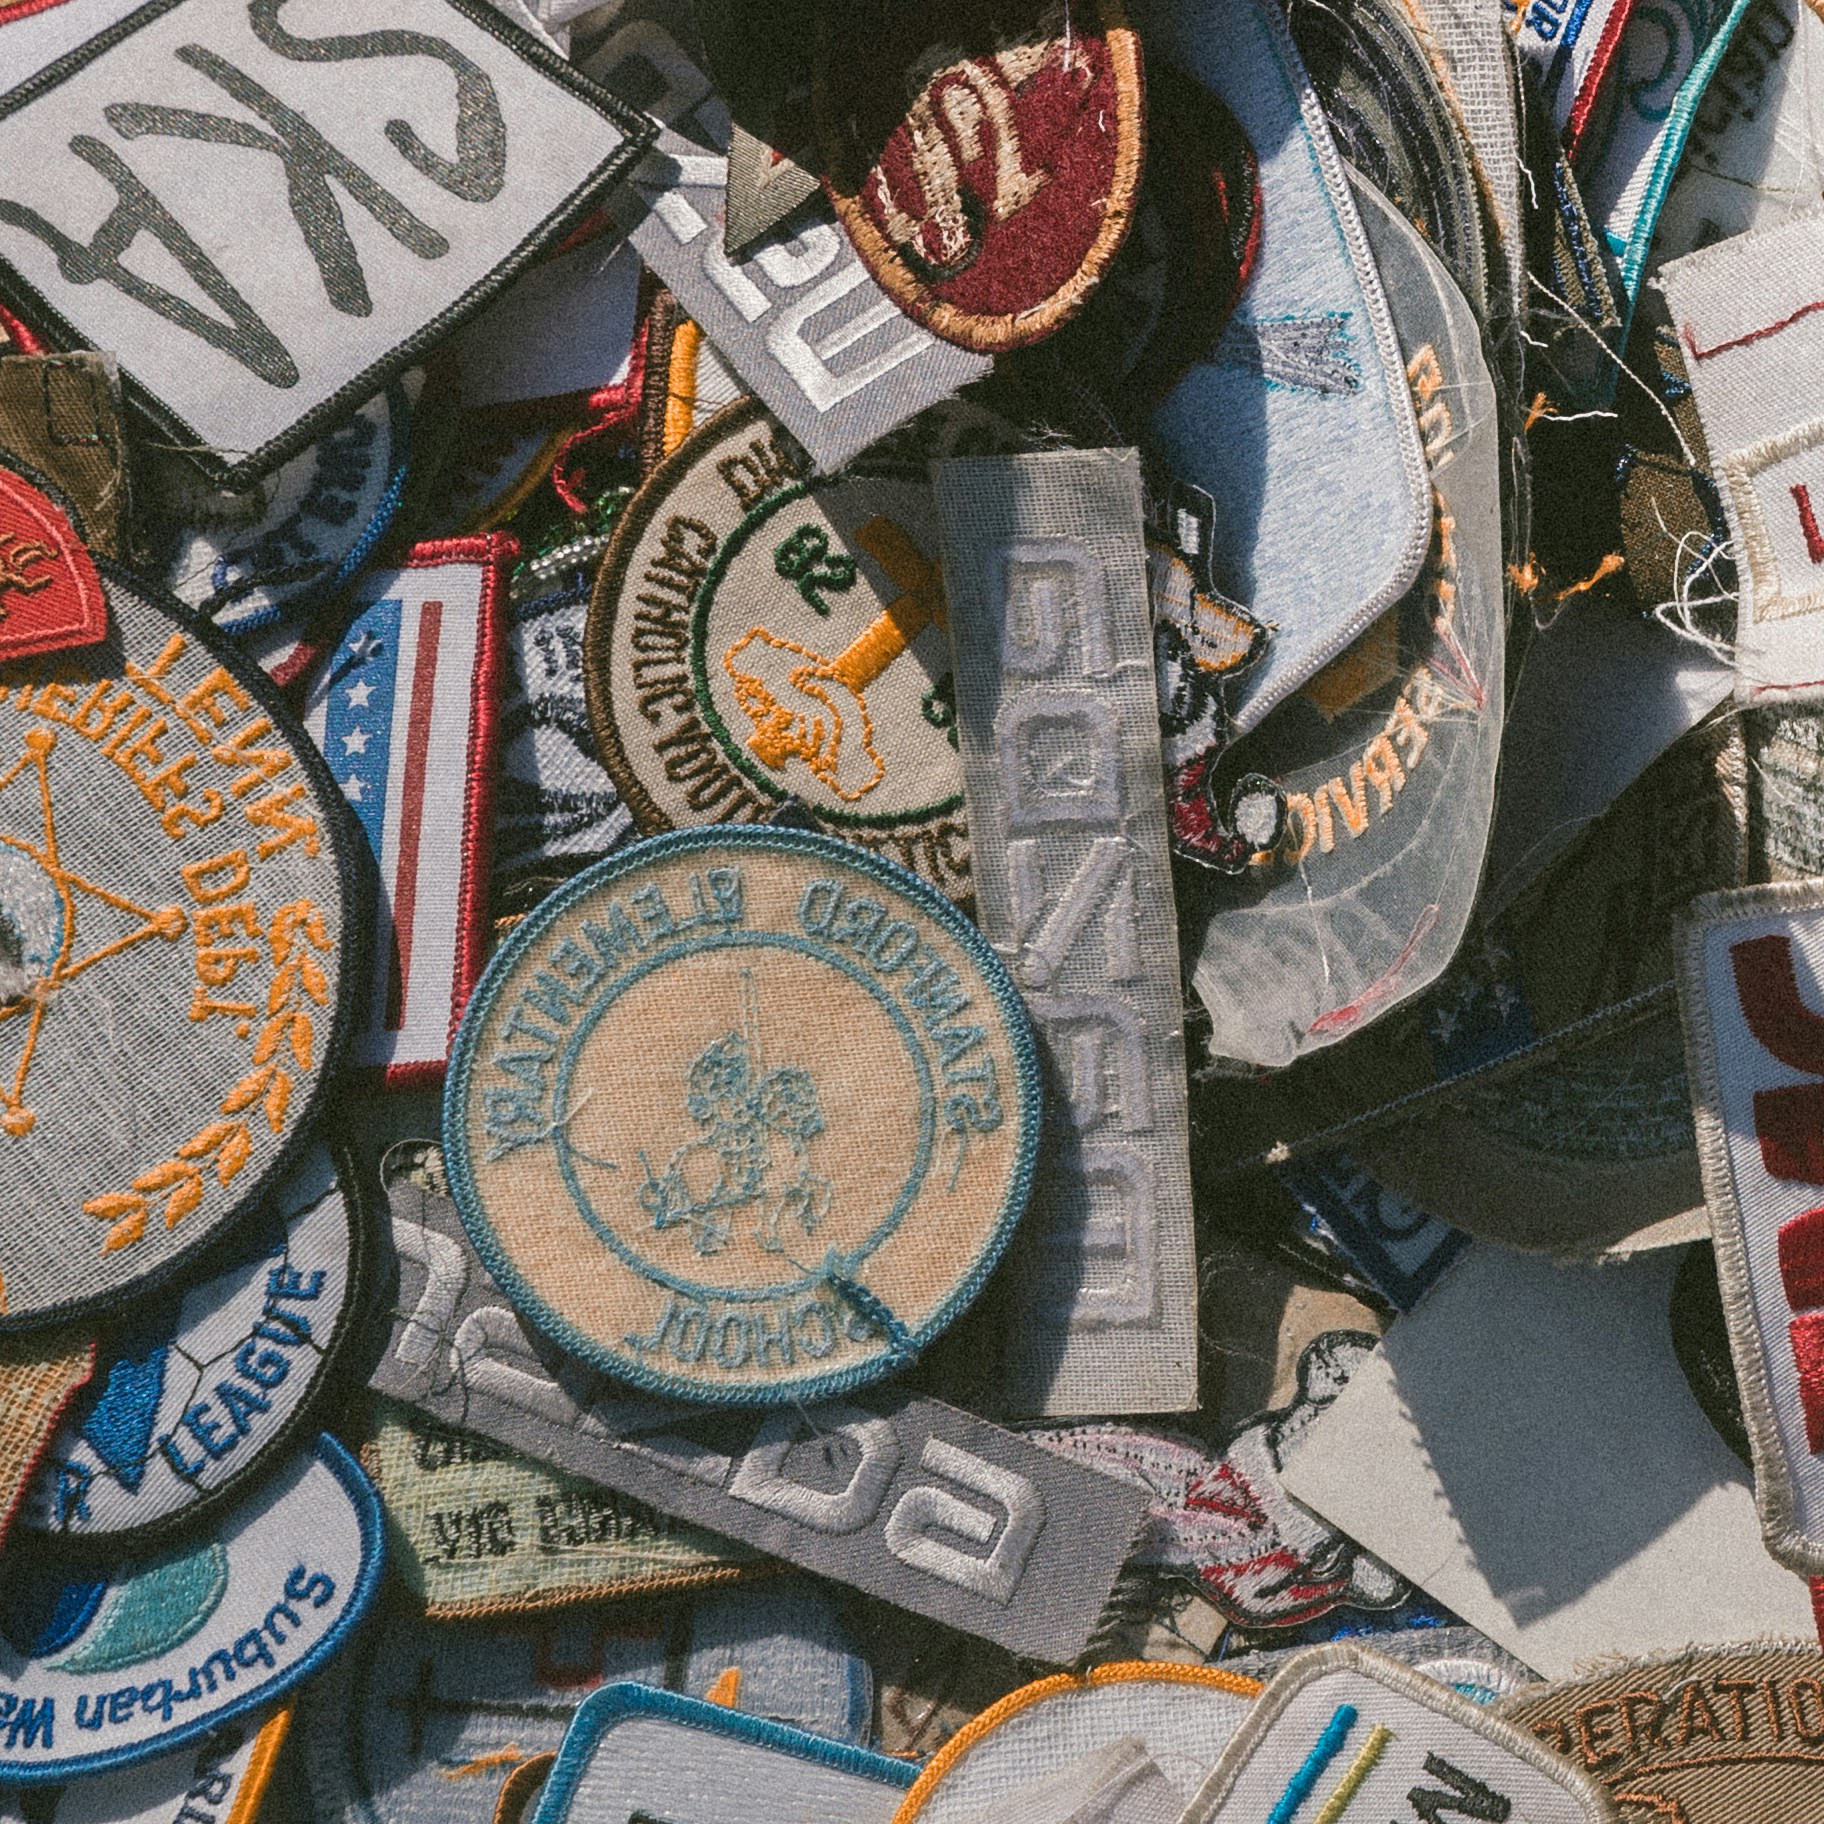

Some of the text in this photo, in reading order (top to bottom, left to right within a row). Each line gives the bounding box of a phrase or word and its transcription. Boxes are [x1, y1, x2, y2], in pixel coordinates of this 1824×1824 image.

[629, 513, 718, 732] CATHOLIC
[156, 1265, 326, 1478] LEAGUE
[73, 1566, 337, 1732] Suburban
